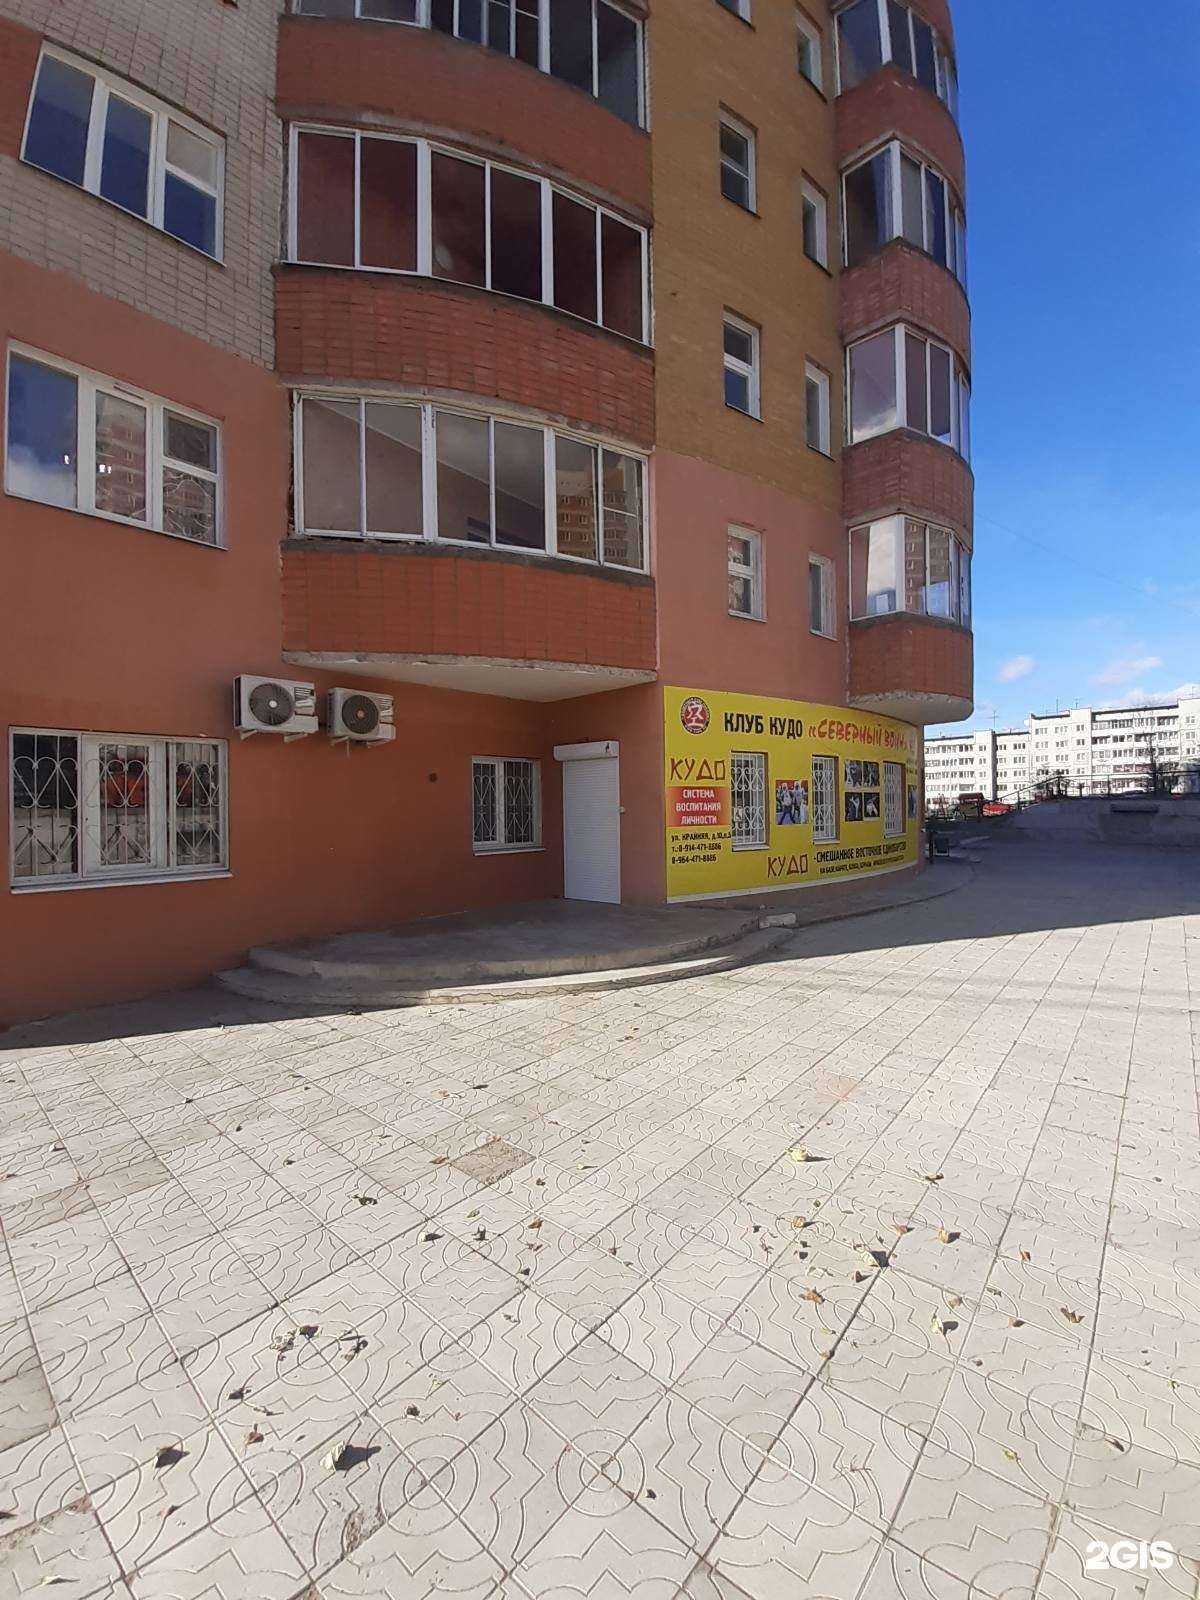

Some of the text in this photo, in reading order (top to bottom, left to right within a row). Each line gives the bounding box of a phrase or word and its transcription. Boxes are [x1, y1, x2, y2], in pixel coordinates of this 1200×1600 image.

[724, 712, 764, 735] КЛУБ
[769, 716, 803, 740] КУДО
[670, 757, 726, 781] КУДО
[682, 789, 715, 799] СИСТЕМА
[675, 802, 721, 812] ВОСПИТАНИЯ
[680, 815, 717, 825] ЛИЧНОСТИ
[767, 853, 809, 878] КУДО
